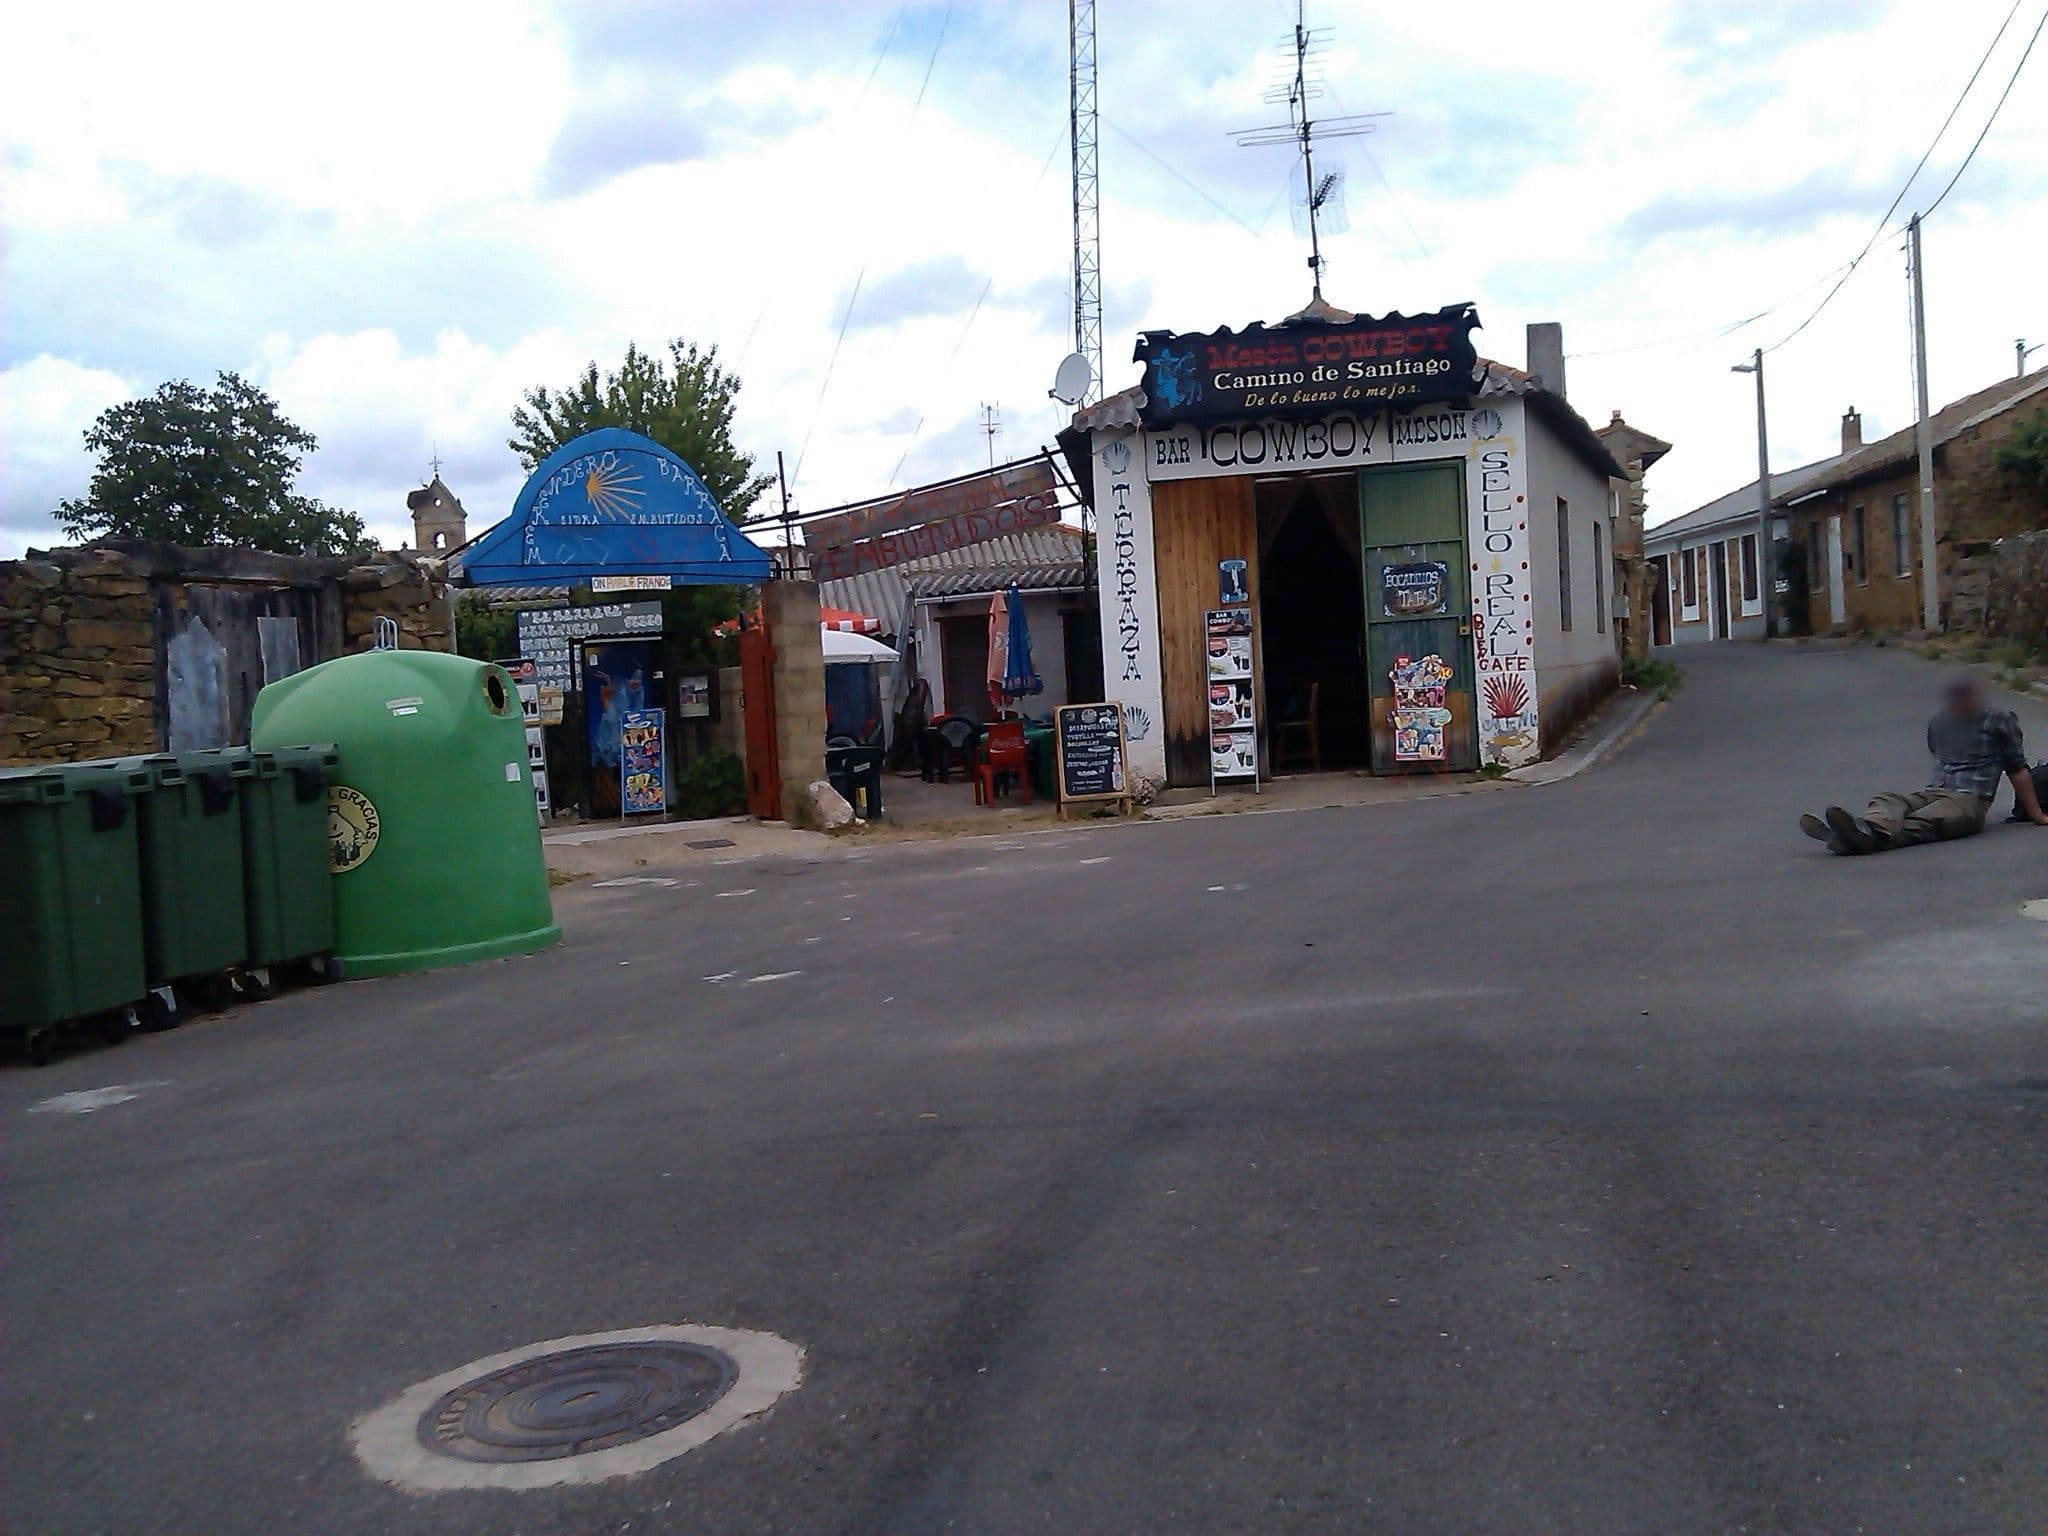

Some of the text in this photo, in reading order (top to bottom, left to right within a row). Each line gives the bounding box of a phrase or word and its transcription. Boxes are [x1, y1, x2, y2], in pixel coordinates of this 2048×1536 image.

[1303, 325, 1454, 362] COWBOY
[1213, 358, 1451, 391] Camino de Santiago
[1244, 393, 1265, 408] De
[1270, 391, 1287, 405] lo
[1292, 390, 1337, 404] bueno
[1342, 386, 1361, 399] lo
[1155, 411, 1467, 468] BAR COWBOY MESON
[524, 451, 732, 565] MERENDERO BARRACA
[560, 513, 704, 525] SIDRA EMBUTIDOS
[1481, 451, 1518, 657] SELLO REAL
[593, 578, 606, 589] ON
[1111, 483, 1142, 682] TERRAZA
[1398, 586, 1438, 608] TAPAS
[339, 788, 378, 840] GRACIAS
